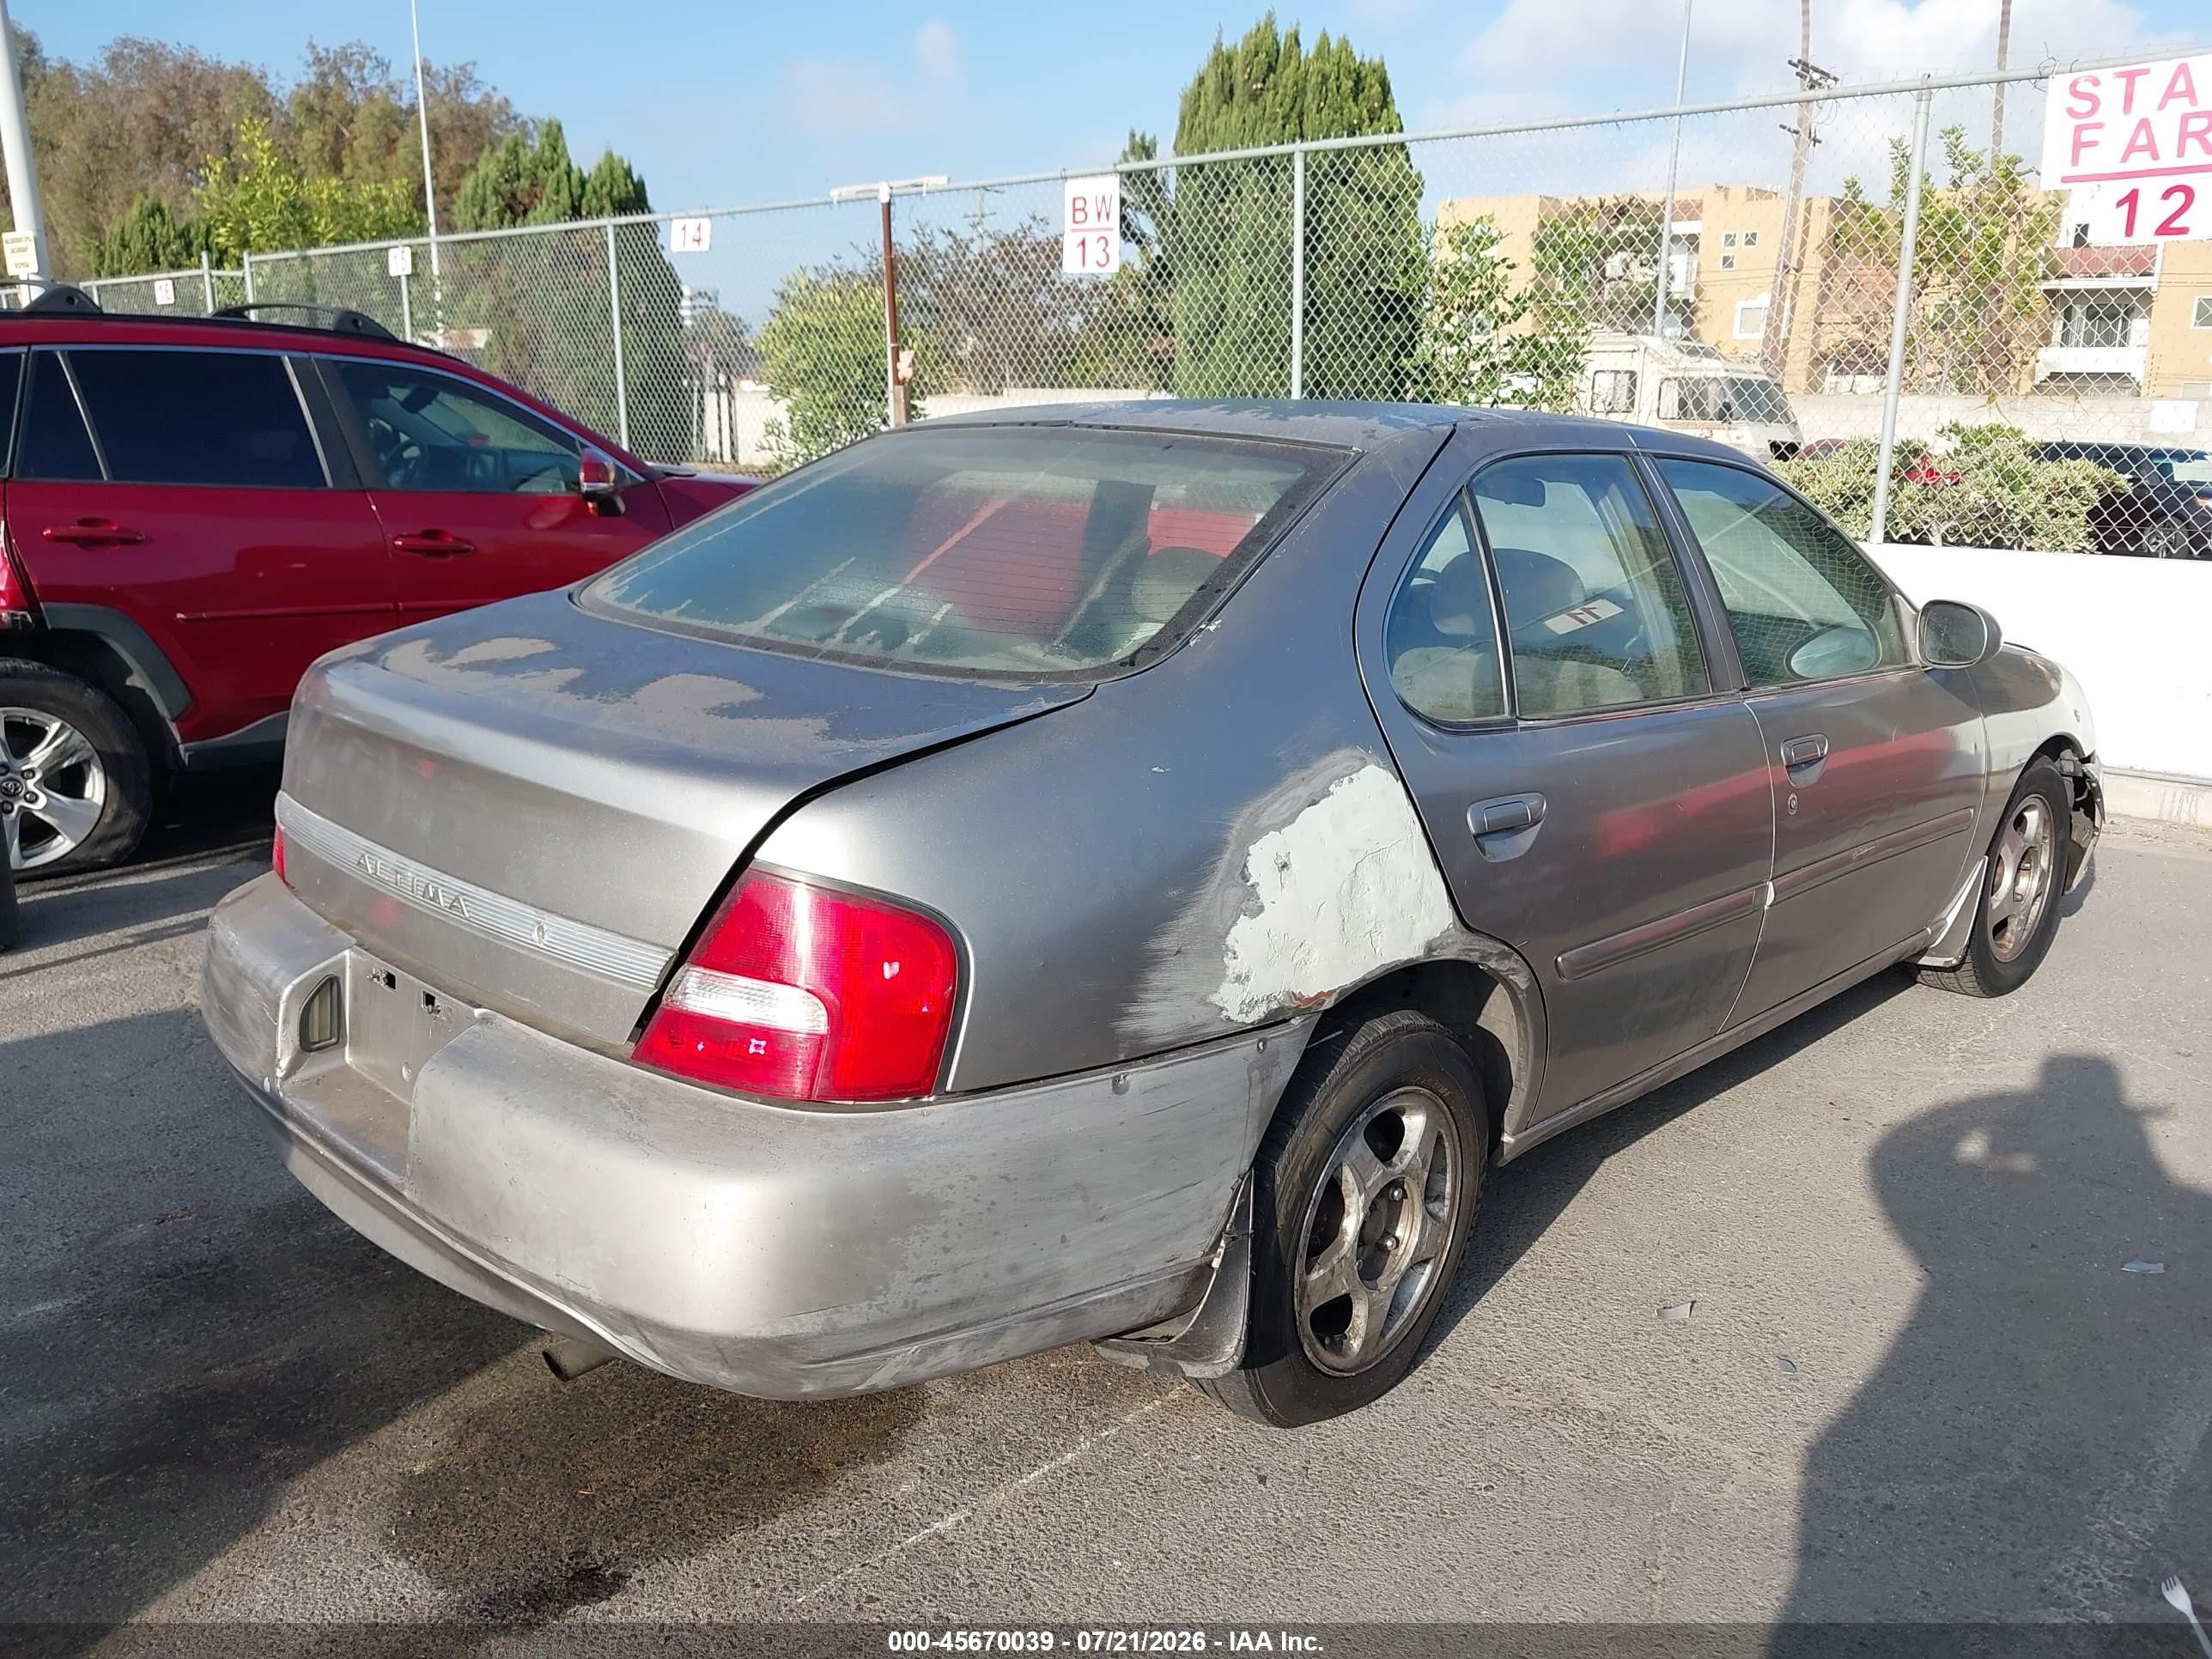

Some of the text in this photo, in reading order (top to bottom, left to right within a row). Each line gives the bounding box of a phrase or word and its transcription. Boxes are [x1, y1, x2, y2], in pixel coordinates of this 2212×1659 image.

[2066, 62, 2198, 119] STA
[2070, 110, 2212, 167] FAR
[680, 222, 702, 248] 14
[2115, 184, 2195, 237] 12
[1077, 235, 1110, 269] 13
[357, 852, 471, 919] ALTIMA
